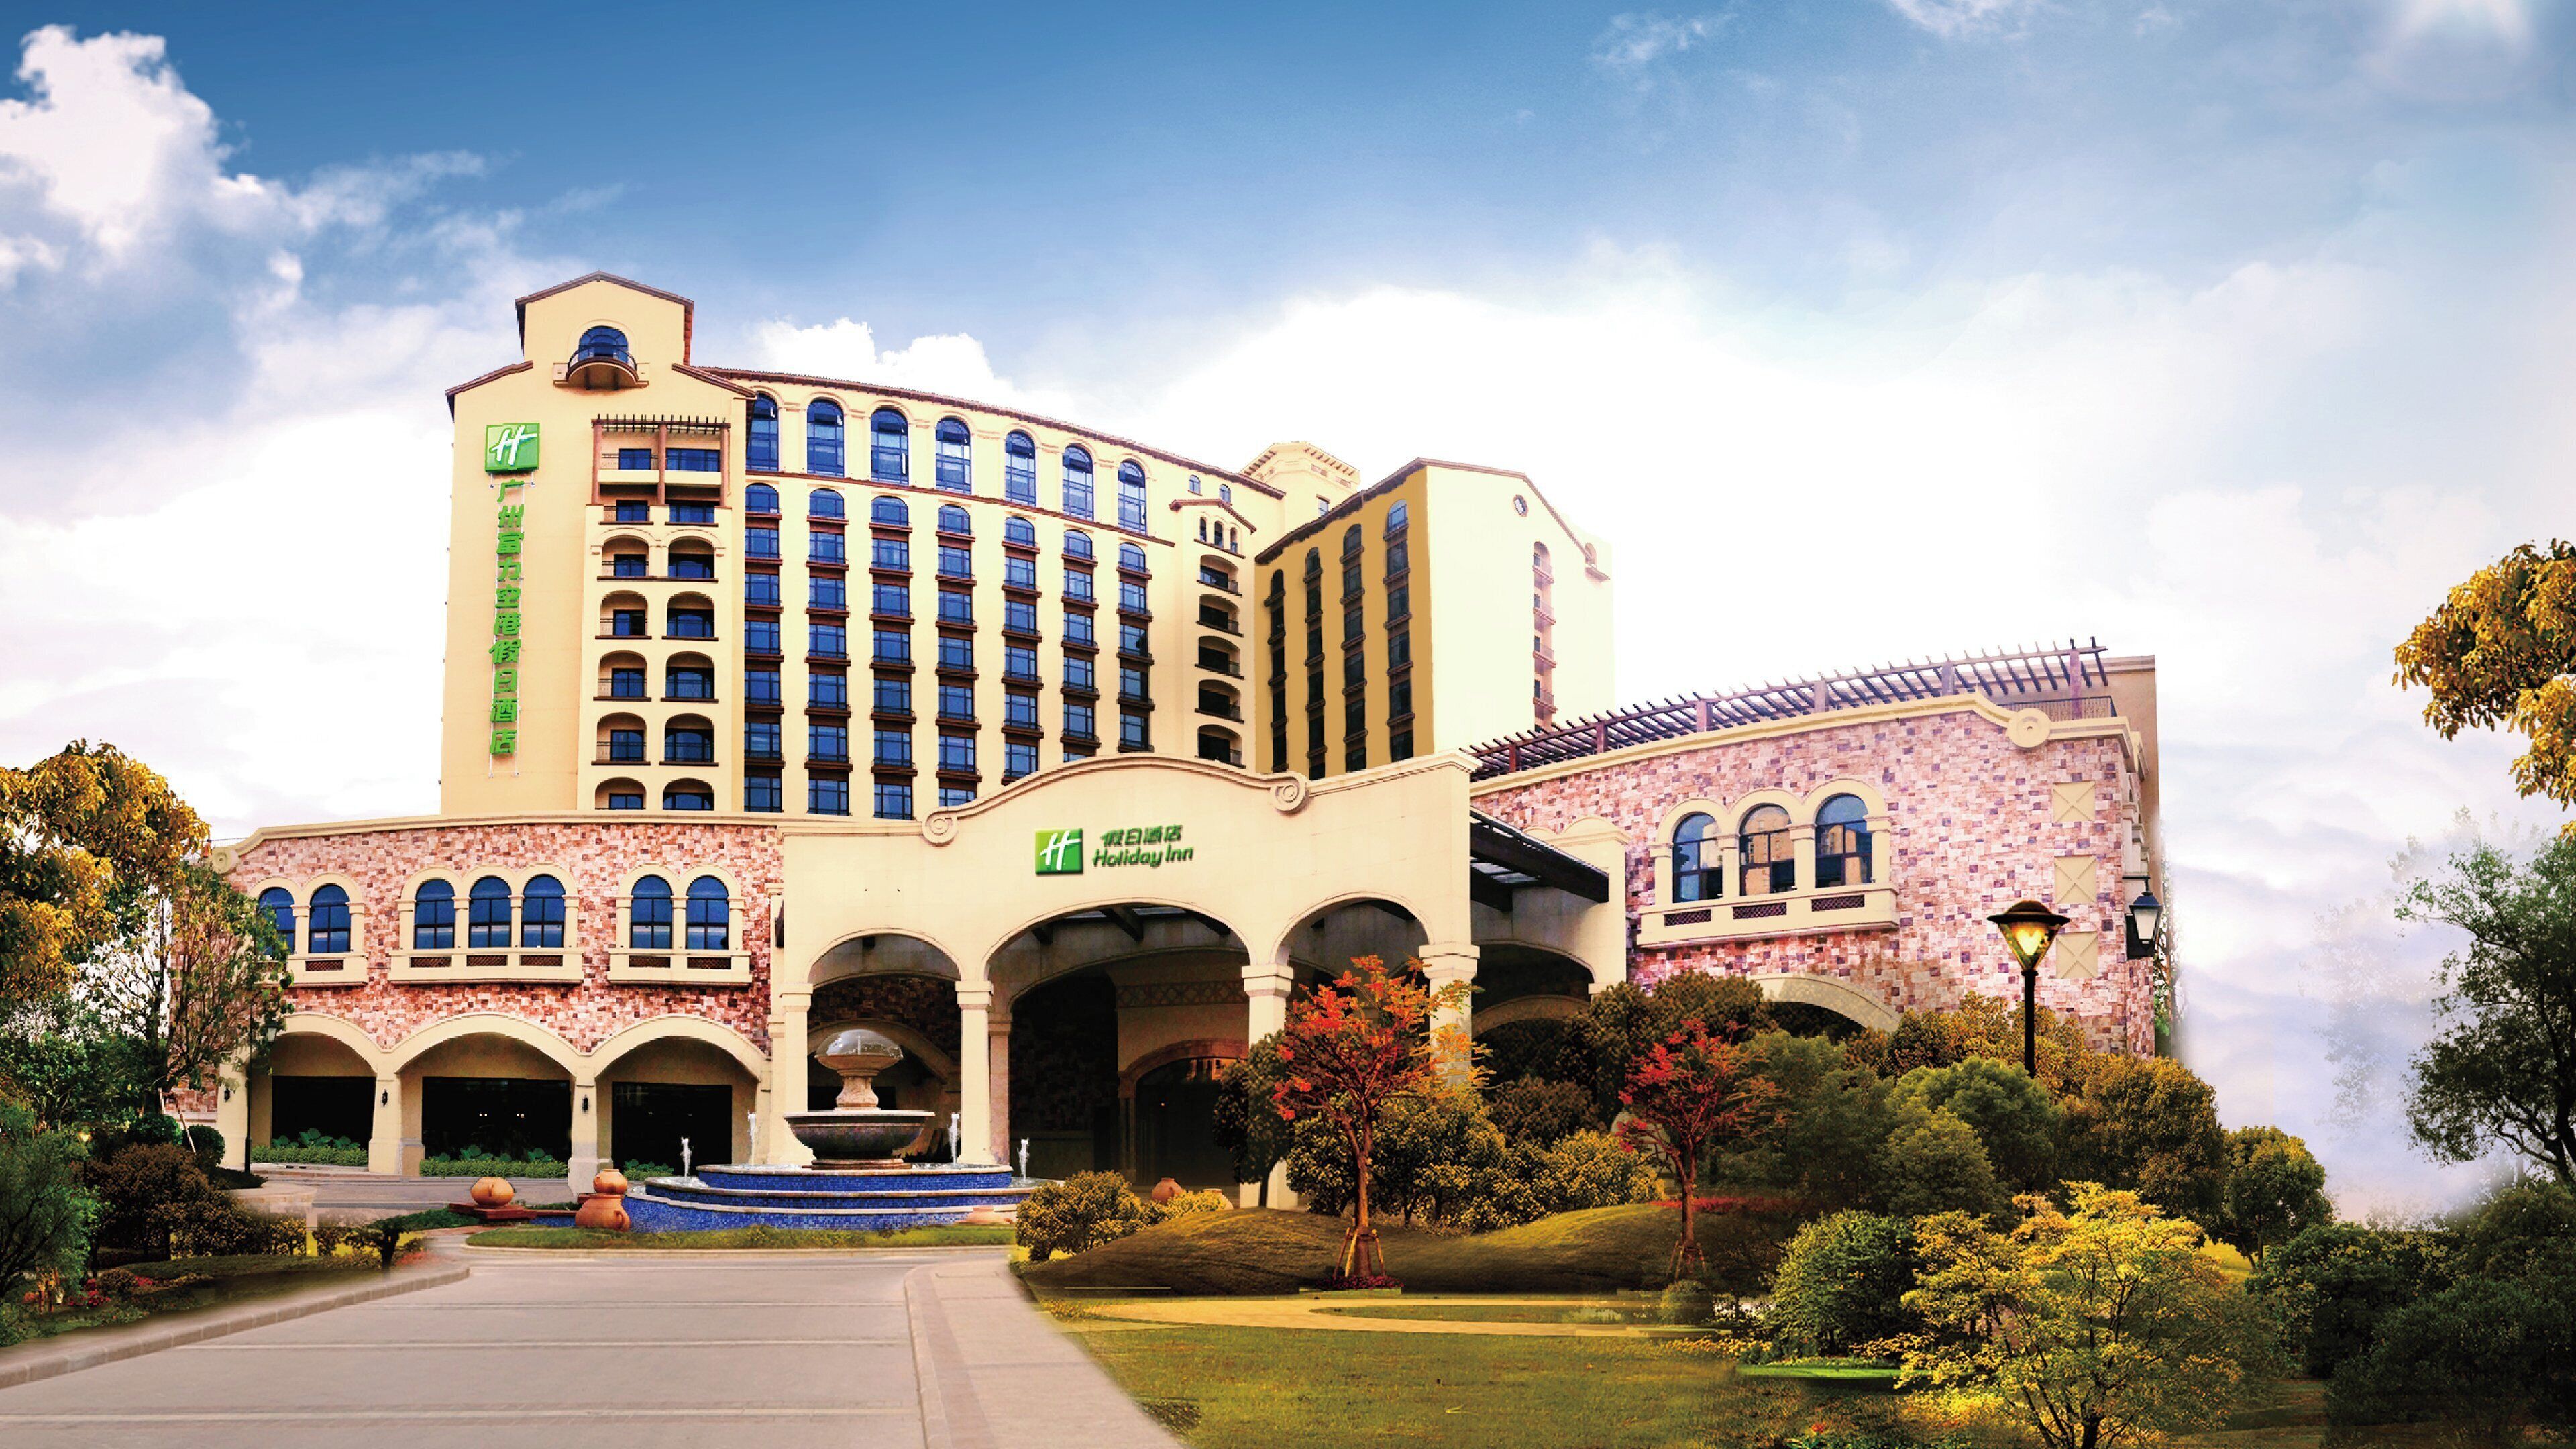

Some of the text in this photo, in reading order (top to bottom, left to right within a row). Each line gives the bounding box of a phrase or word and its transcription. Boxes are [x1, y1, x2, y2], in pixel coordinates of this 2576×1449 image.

[489, 480, 525, 755] 广州富力空港假日酒店
[1100, 825, 1183, 847] 假日酒店
[1092, 844, 1194, 868] Holiday Inn
